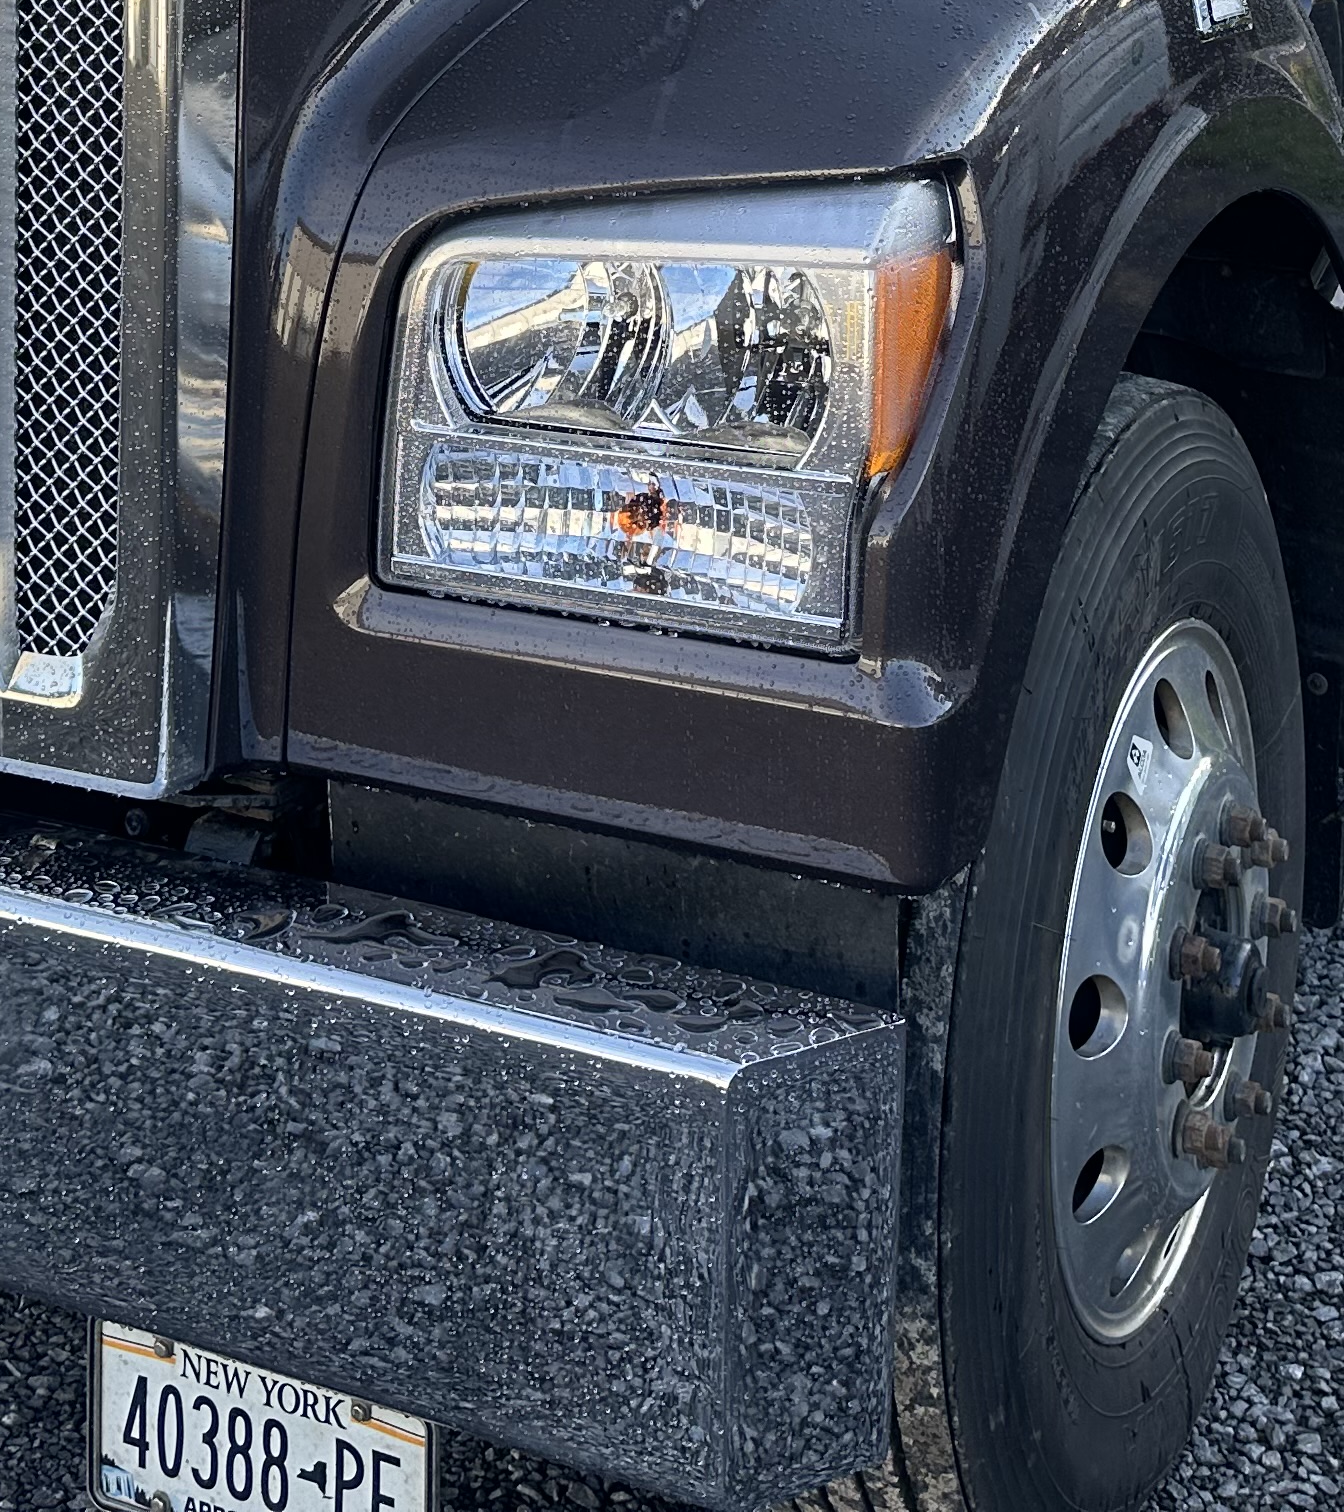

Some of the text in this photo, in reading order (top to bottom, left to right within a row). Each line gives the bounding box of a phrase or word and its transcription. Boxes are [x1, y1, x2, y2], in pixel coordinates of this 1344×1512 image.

[122, 1374, 290, 1512] 40388
[180, 1348, 348, 1430] NEW YORK
